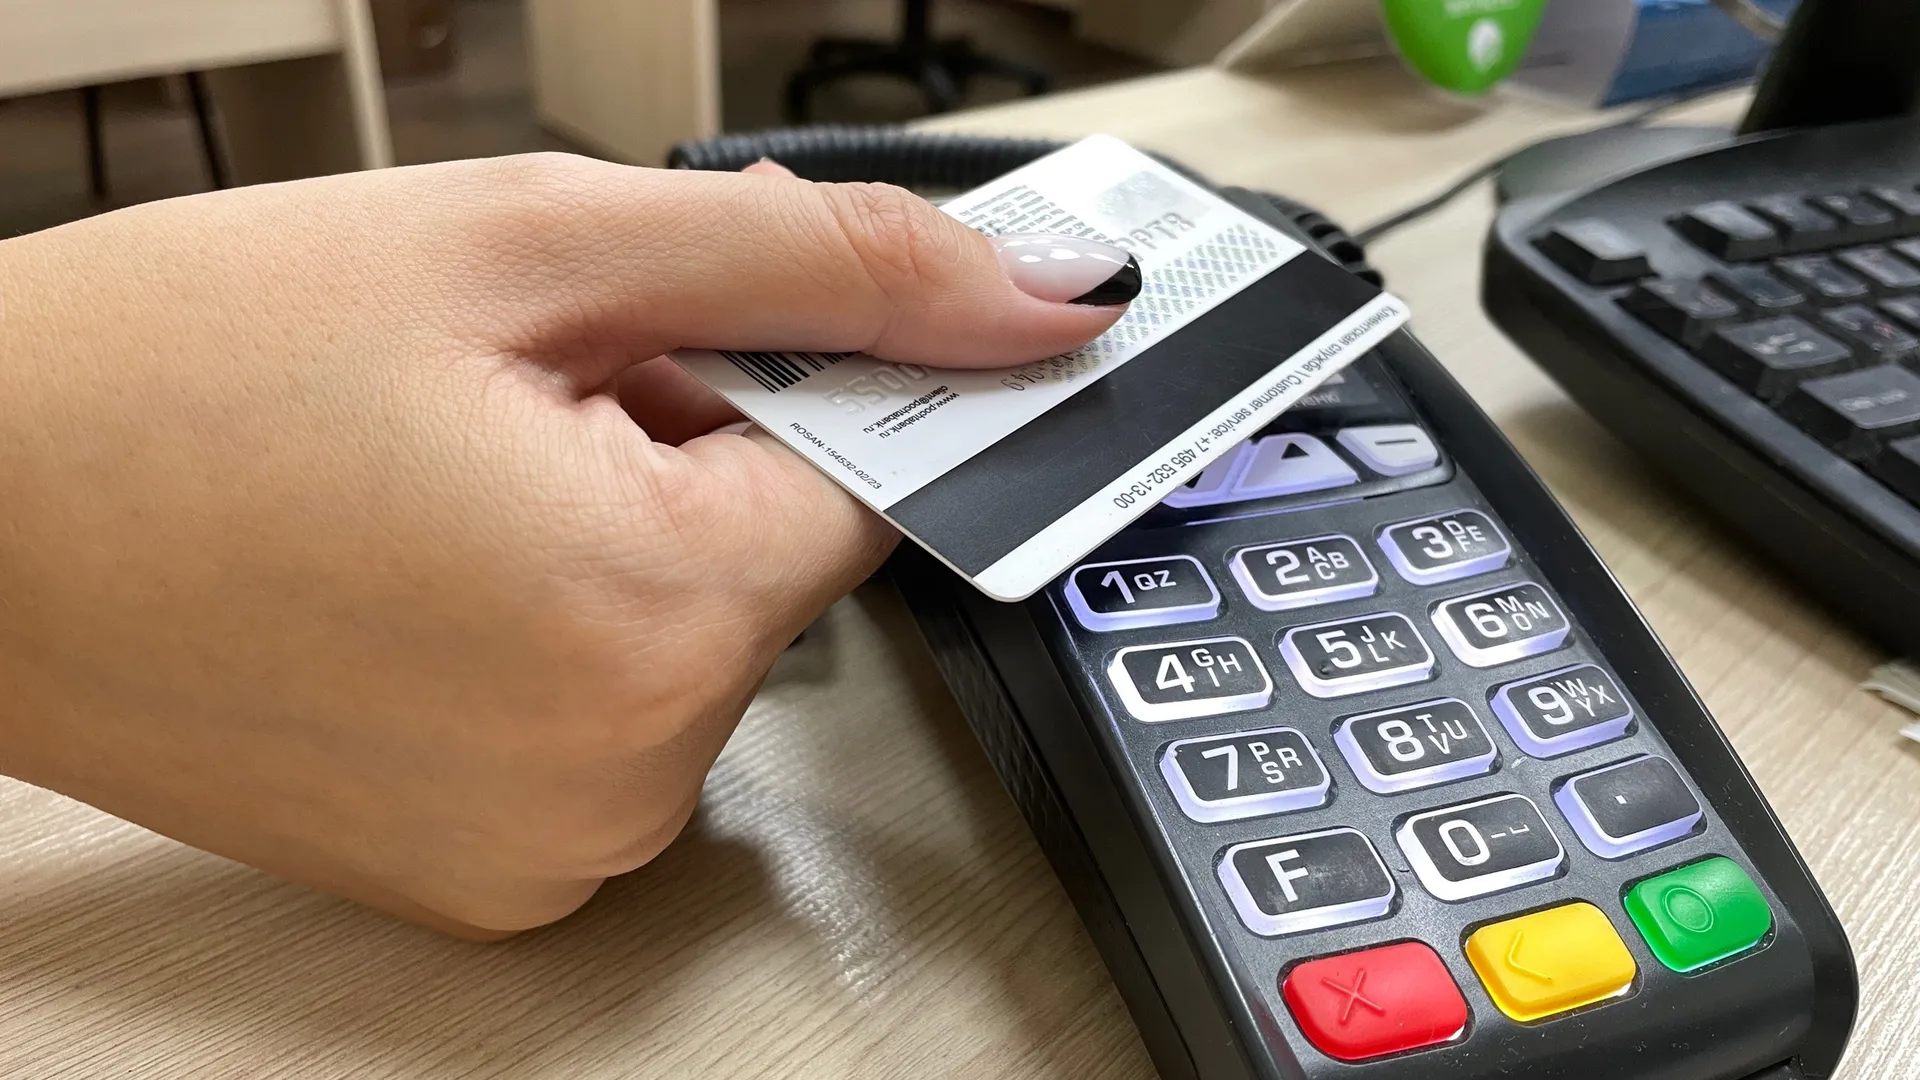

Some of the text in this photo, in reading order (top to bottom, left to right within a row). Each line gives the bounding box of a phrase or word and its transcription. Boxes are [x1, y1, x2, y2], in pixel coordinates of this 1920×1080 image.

[1340, 306, 1399, 347] Клиентская
[1303, 343, 1342, 374] служба
[862, 385, 949, 434] client@pochtabank.ru
[1249, 375, 1302, 412] Customer
[878, 392, 960, 439] www.pochtabank.ru
[1209, 408, 1252, 440] service:
[789, 422, 882, 490] ROSAN-154532-02/23
[1176, 450, 1198, 469] 495
[1194, 437, 1210, 454] +7
[1113, 461, 1177, 510] 532-13-00
[1412, 526, 1453, 559] 3
[1101, 569, 1177, 604] 1 QZ
[1267, 549, 1309, 586] 2
[1465, 602, 1508, 638] 6
[1315, 630, 1363, 669] 5
[1155, 653, 1195, 694] 4
[1528, 686, 1574, 725] 9
[1377, 720, 1424, 762] 8
[1201, 745, 1240, 791] 7
[1437, 818, 1490, 866] 0
[1268, 848, 1310, 902] F
